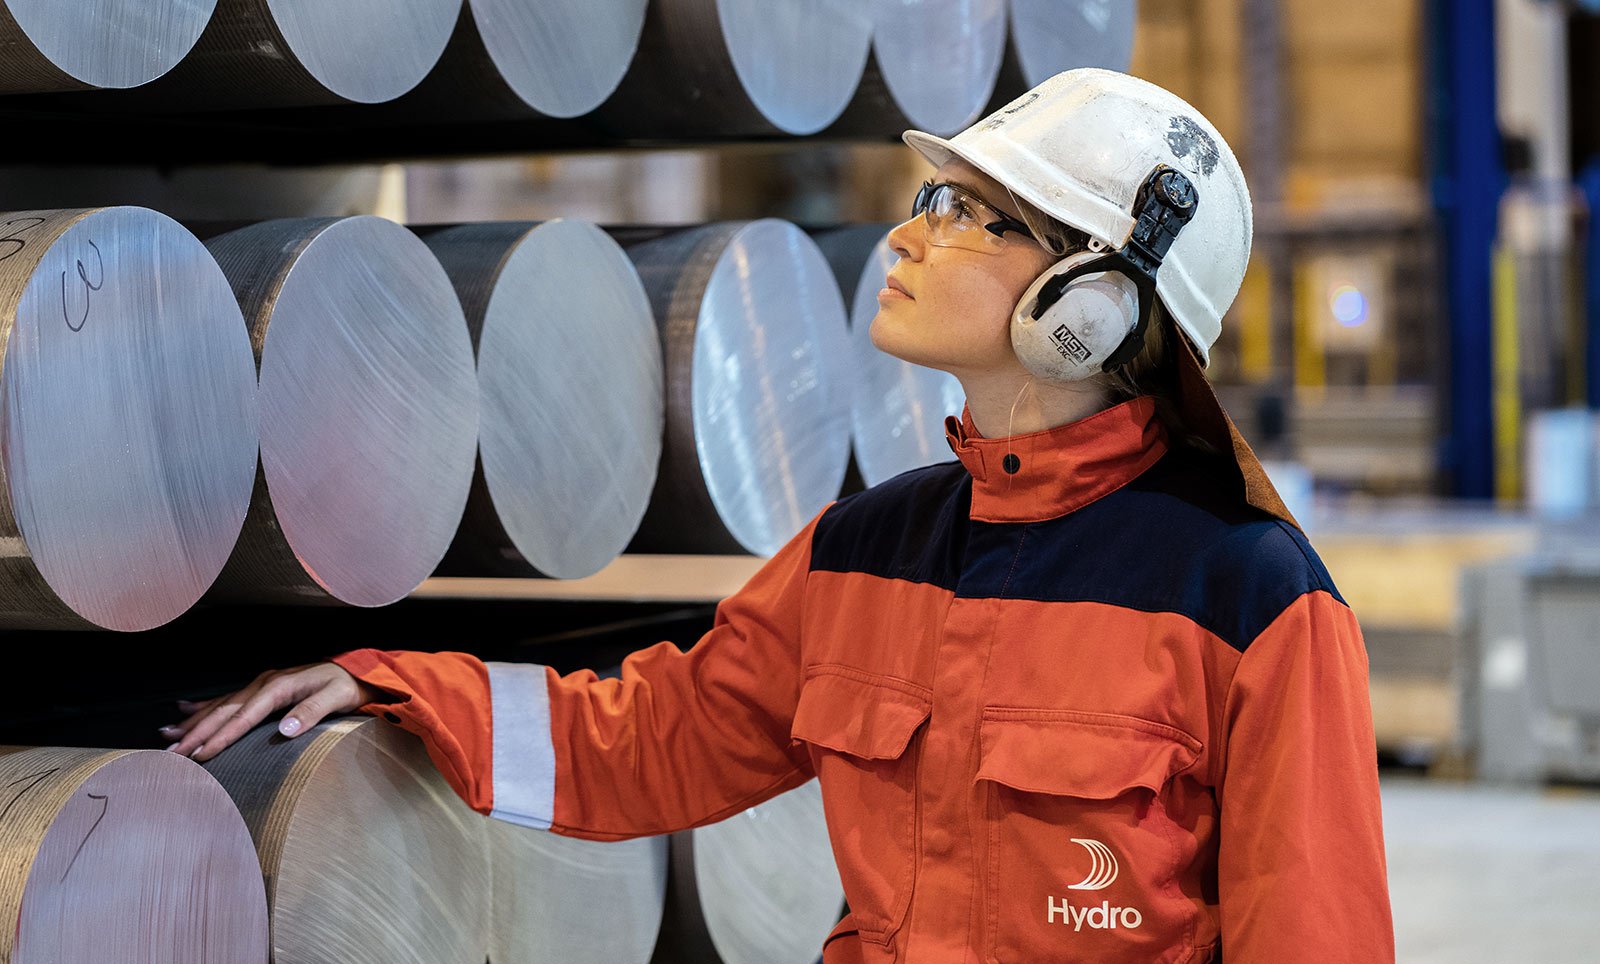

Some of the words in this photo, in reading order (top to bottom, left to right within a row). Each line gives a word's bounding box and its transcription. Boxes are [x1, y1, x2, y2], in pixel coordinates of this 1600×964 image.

[1055, 326, 1089, 362] MSA
[1056, 345, 1071, 360] EXC
[1047, 895, 1143, 932] Hydro
